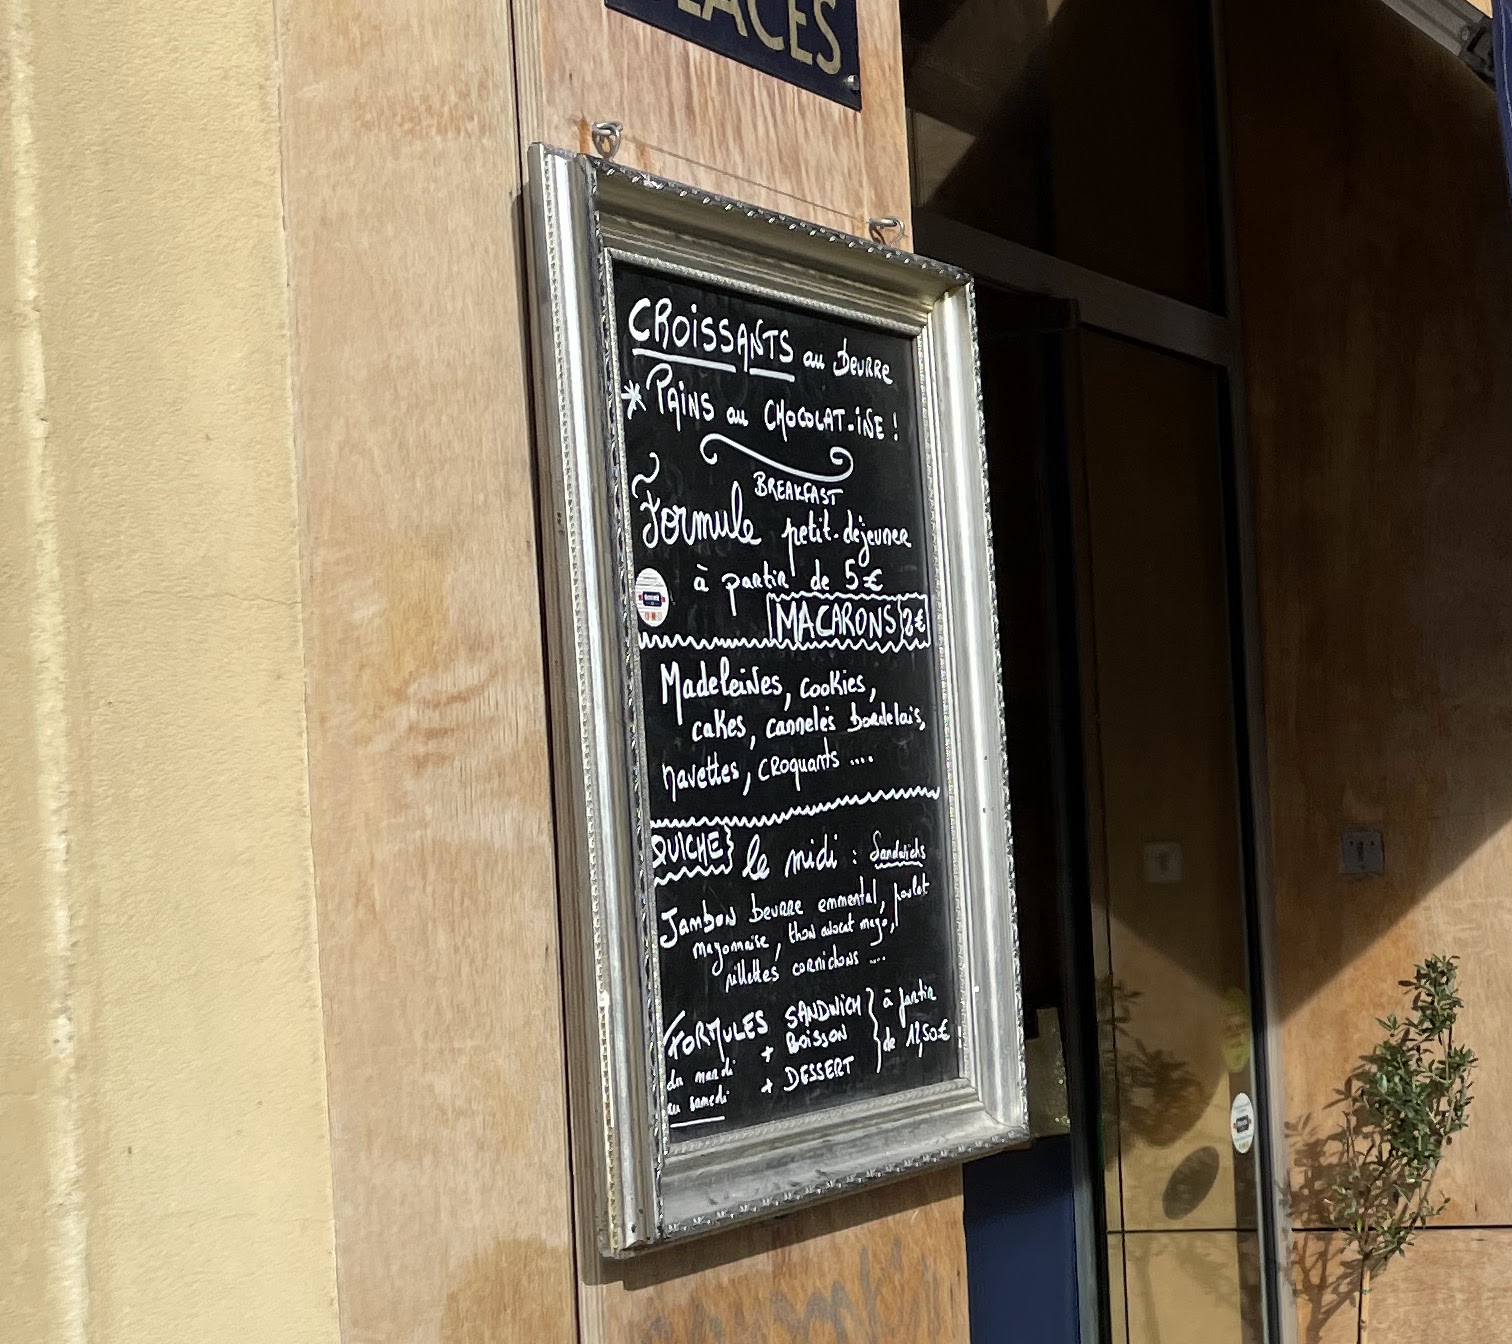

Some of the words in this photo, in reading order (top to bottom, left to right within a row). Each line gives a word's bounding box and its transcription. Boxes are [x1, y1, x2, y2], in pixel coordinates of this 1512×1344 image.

[802, 349, 826, 371] au
[645, 362, 716, 433] PAINS
[726, 406, 750, 428] au
[633, 452, 763, 549] Formule
[752, 469, 845, 506] BREAKFAST
[693, 563, 710, 593] à
[721, 560, 789, 617] partir
[810, 558, 831, 591] de
[775, 600, 898, 643] MACARONS
[651, 829, 724, 869] QUICHE
[741, 833, 771, 882] le
[783, 826, 839, 879] midi
[659, 899, 738, 950] Jambon
[748, 892, 804, 924] beurre
[791, 943, 861, 978] cornichons
[662, 1009, 770, 1063] FORMULES
[783, 992, 863, 1030] SANDWICH
[785, 1023, 849, 1055] BOISSON
[882, 1026, 896, 1053] de
[694, 1056, 737, 1085] mardi
[783, 1054, 856, 1093] DESSERT
[688, 1084, 731, 1113] samedi
